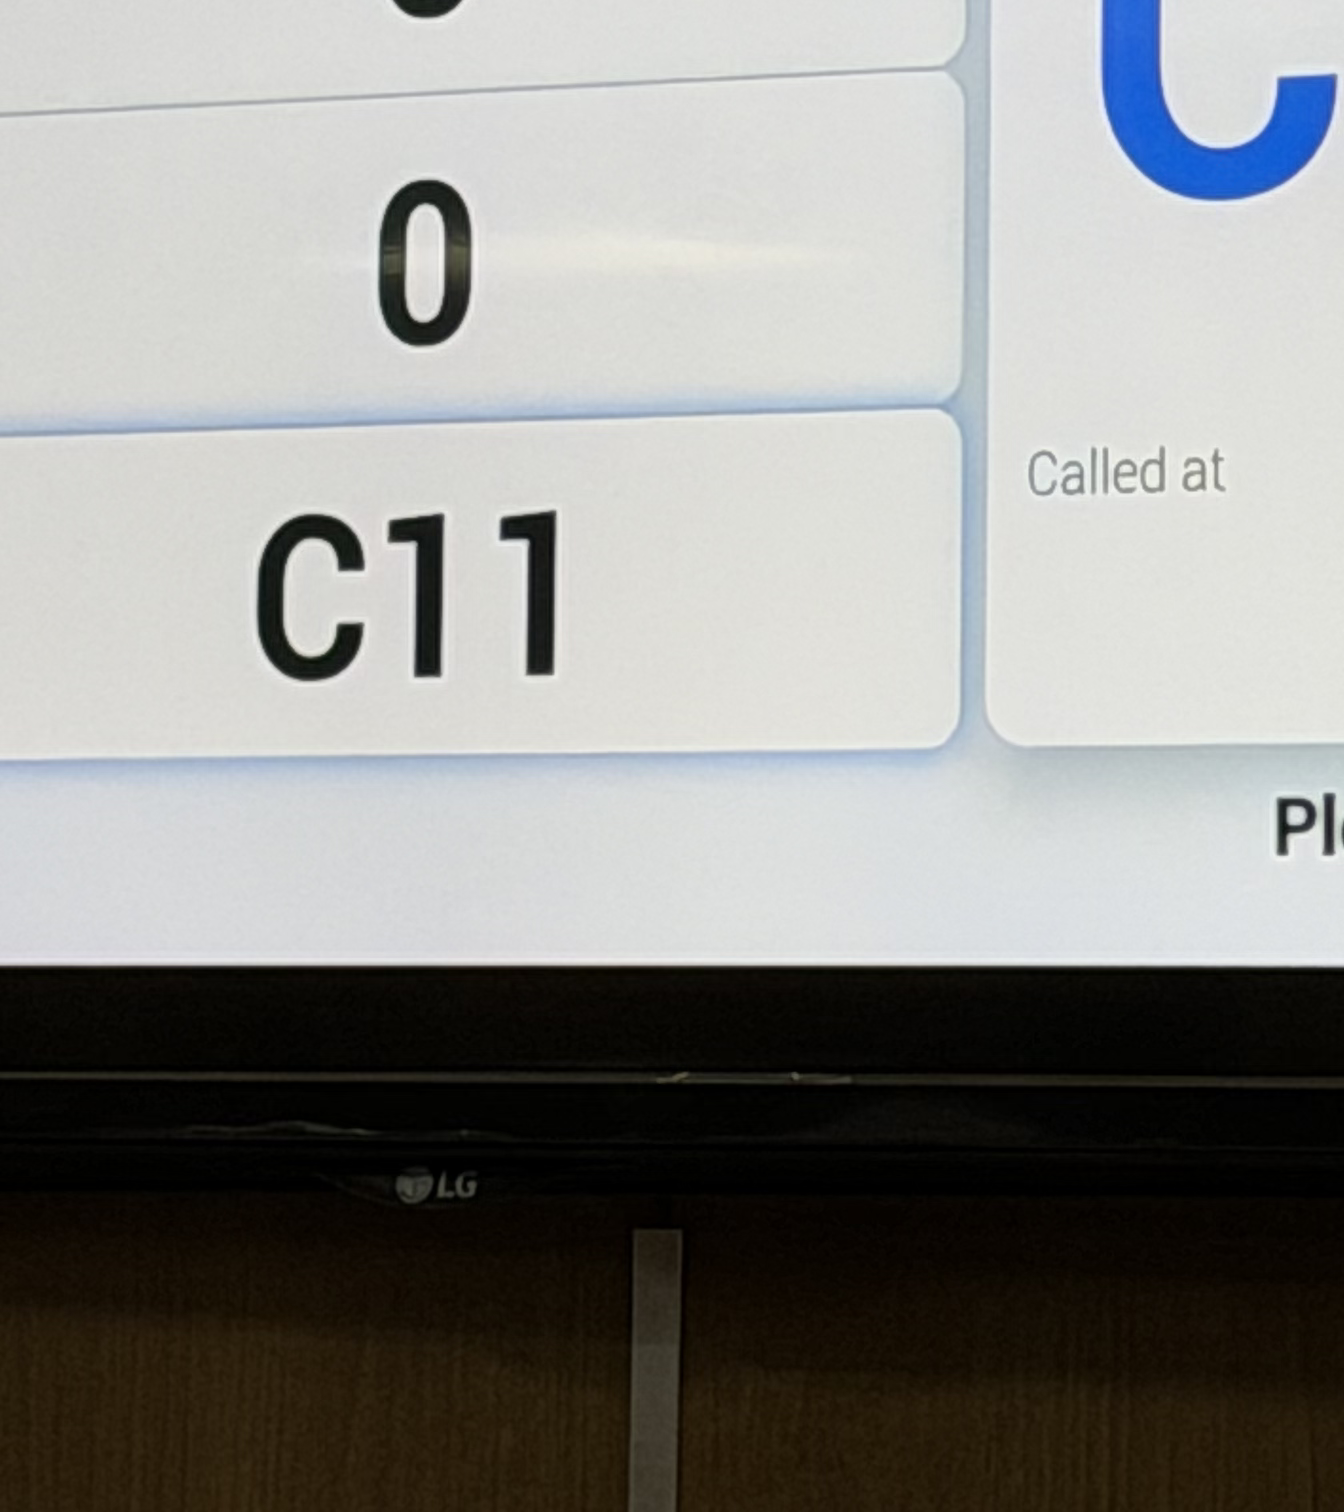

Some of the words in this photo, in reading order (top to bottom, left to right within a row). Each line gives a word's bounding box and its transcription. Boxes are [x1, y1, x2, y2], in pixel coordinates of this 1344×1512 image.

[378, 179, 472, 347] 0
[1028, 445, 1166, 497] Called
[1182, 448, 1226, 492] at
[256, 510, 557, 682] C11
[436, 1170, 478, 1198] LG
